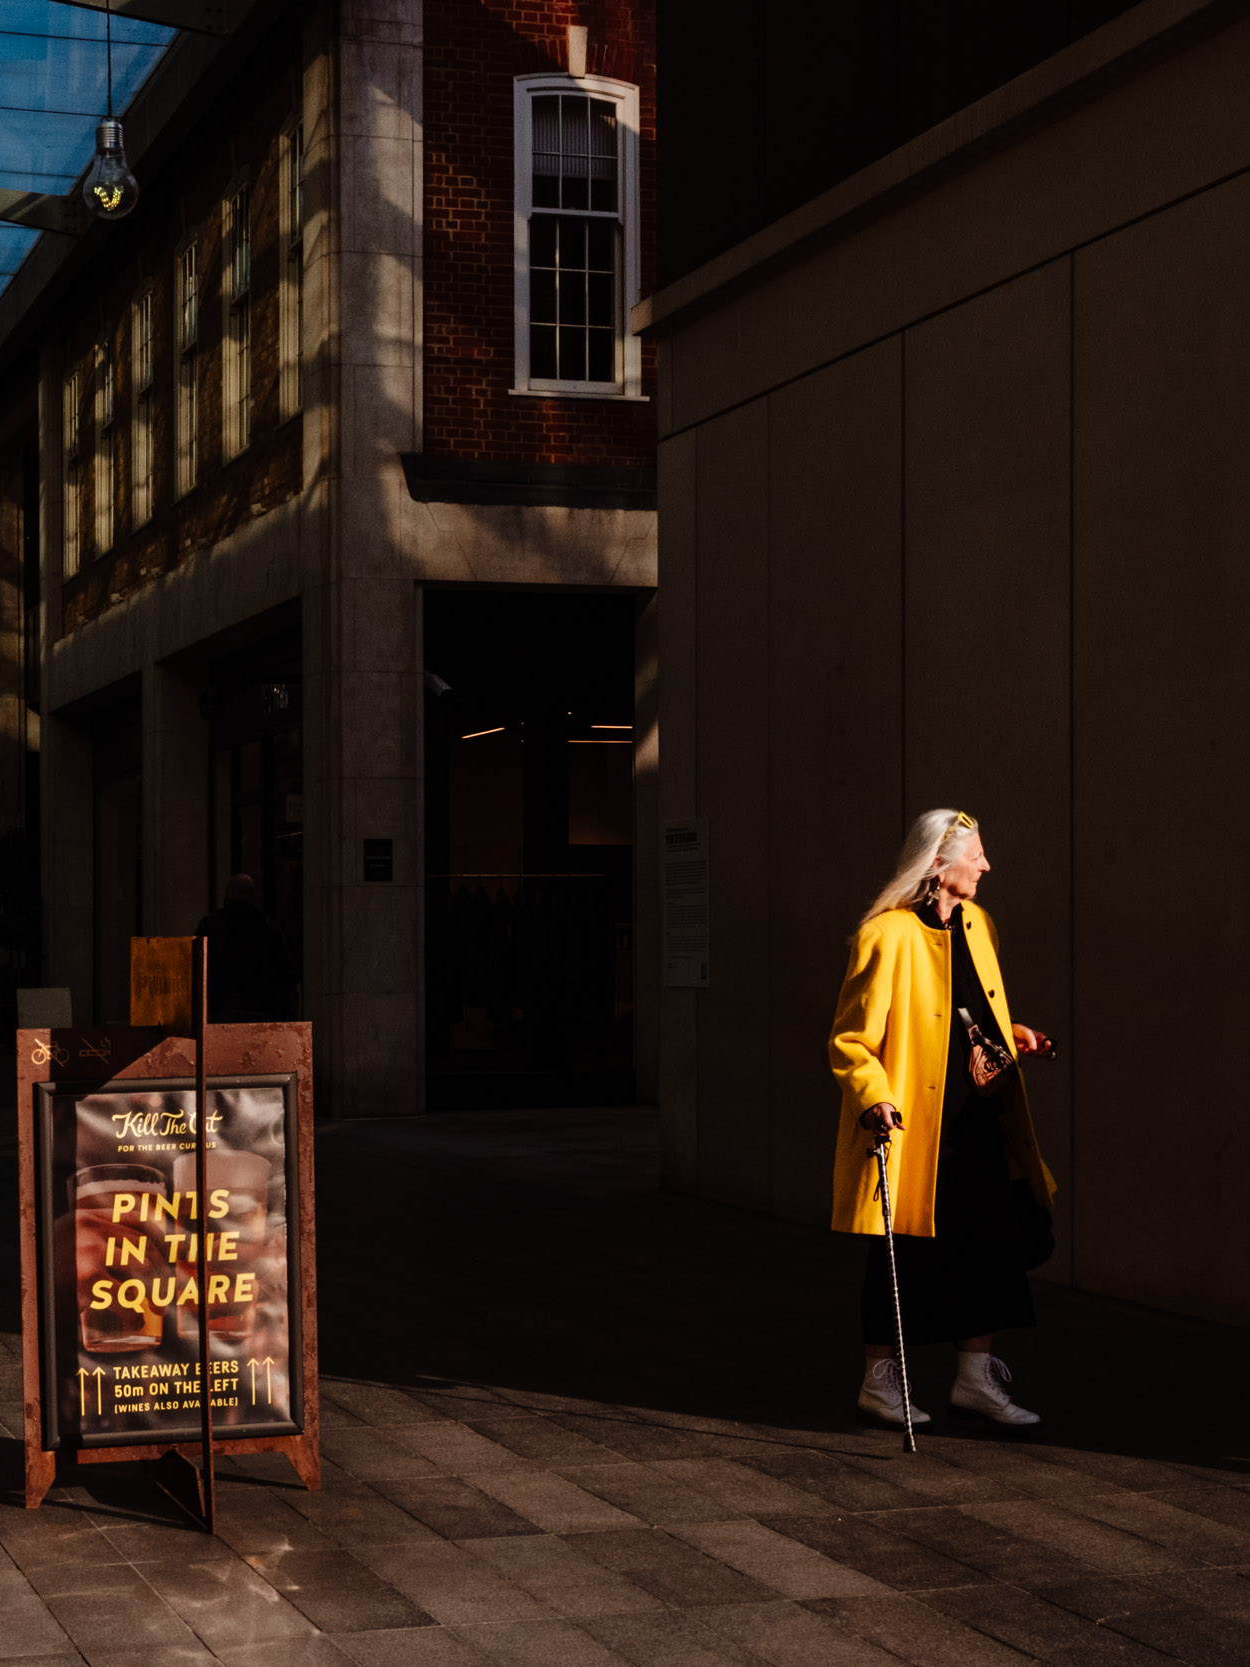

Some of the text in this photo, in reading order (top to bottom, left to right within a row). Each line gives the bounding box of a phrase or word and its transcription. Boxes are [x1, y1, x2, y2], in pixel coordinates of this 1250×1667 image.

[111, 1110, 159, 1139] Kill
[159, 1109, 187, 1136] The
[117, 1141, 217, 1153] FOR THE BEER CURUS
[105, 1236, 147, 1266] IN
[90, 1272, 256, 1313] SQUARE
[113, 1363, 190, 1380] TAKEAWAY
[114, 1384, 144, 1398] 50m
[149, 1382, 169, 1396] ON
[174, 1380, 201, 1394] THE
[114, 1397, 239, 1414] (WINES ALSO AVAABLE)
